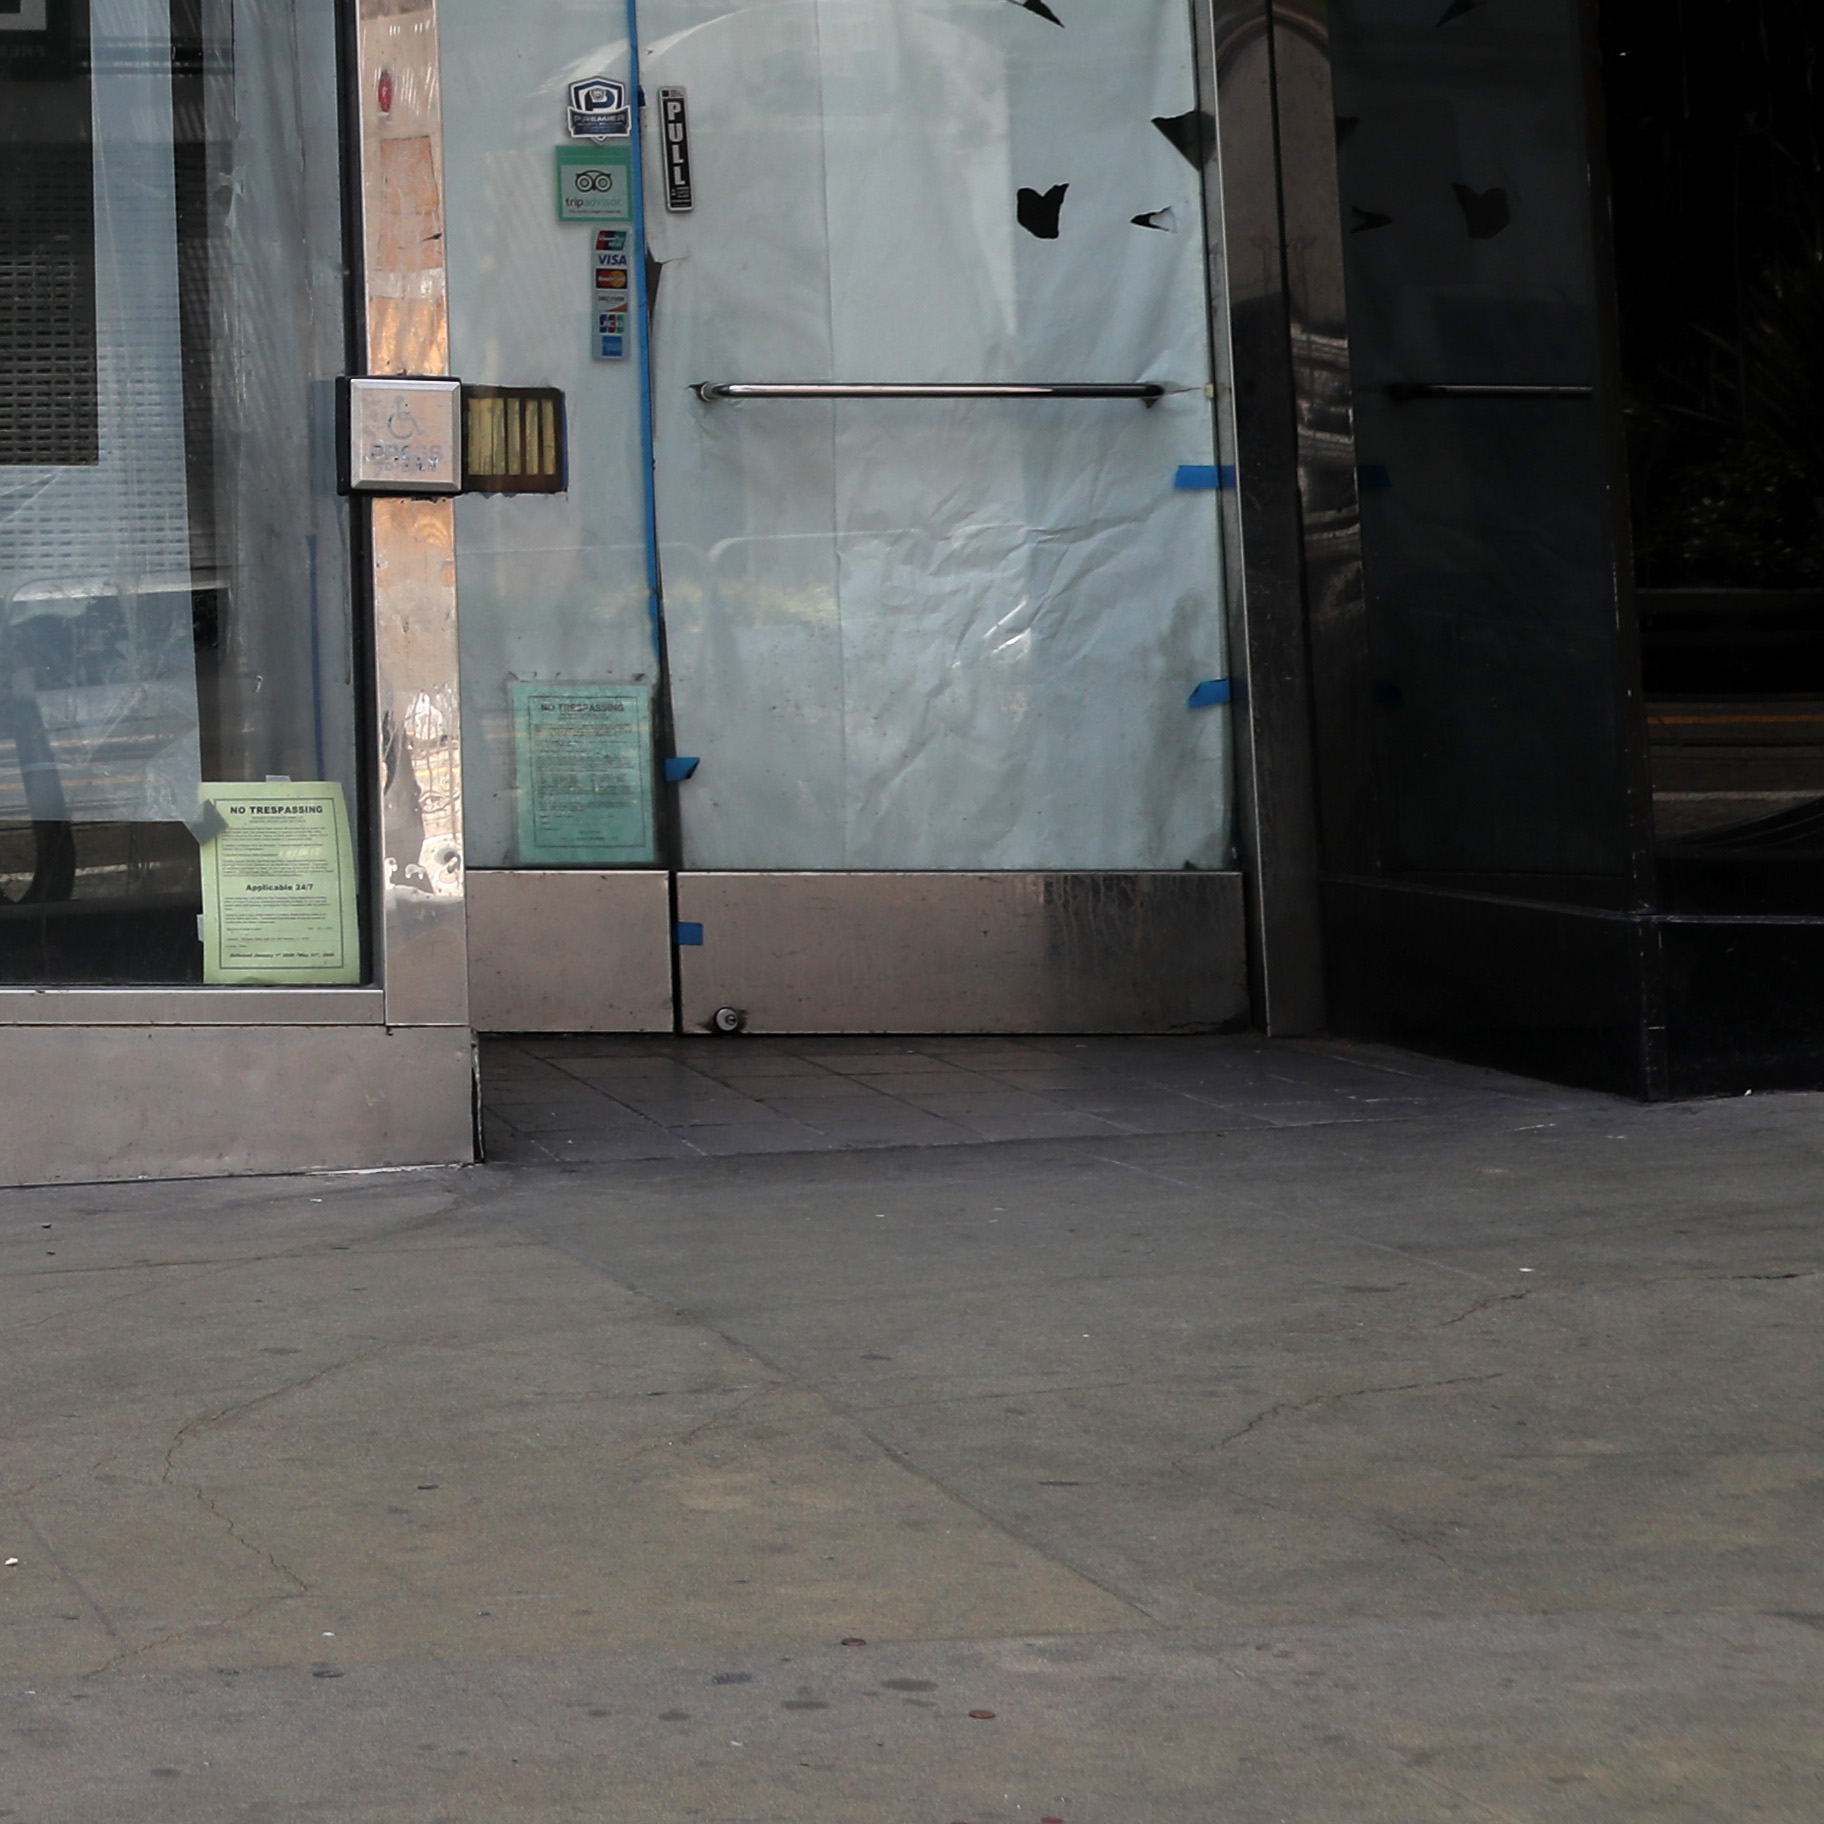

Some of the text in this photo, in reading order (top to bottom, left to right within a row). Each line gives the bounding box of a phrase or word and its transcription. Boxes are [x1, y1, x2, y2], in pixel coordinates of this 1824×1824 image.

[667, 101, 685, 185] PULL
[565, 198, 621, 208] tripadvisor
[598, 255, 627, 266] VISA
[230, 805, 323, 814] NO TRESPASSING
[245, 884, 293, 892] Applicable
